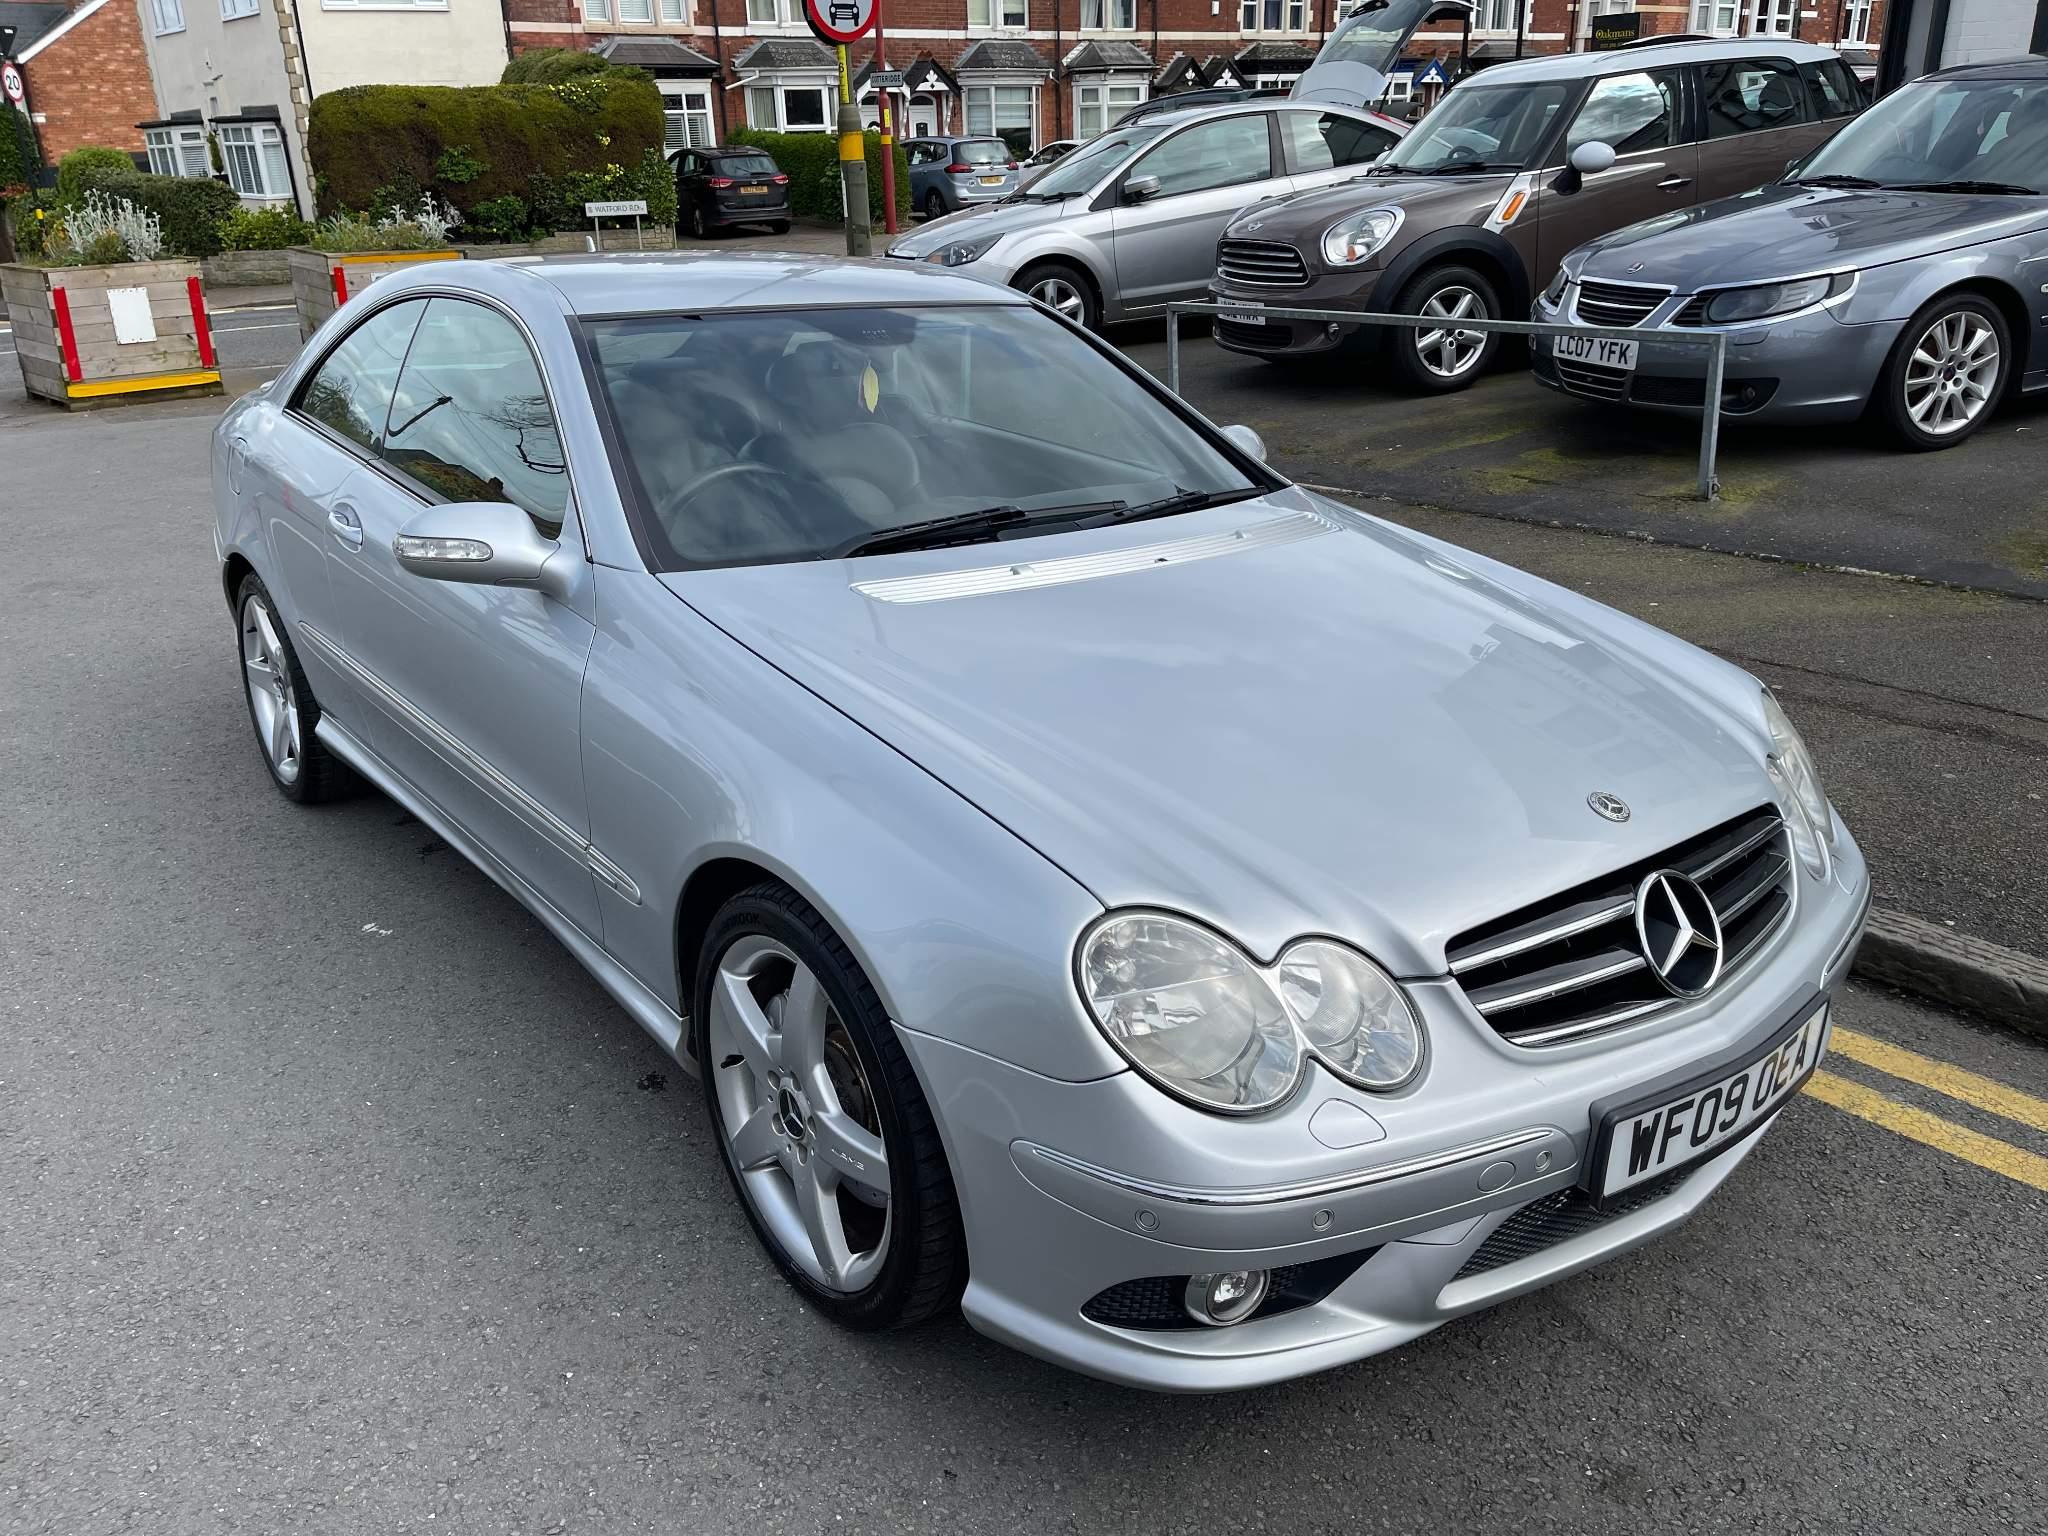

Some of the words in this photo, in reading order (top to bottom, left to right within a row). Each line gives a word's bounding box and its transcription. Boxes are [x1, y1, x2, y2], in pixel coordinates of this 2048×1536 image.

[1595, 28, 1635, 40] Oakmans
[6, 75, 20, 90] 20
[595, 205, 628, 213] WATFORD
[1558, 335, 1595, 359] LC07
[1599, 340, 1631, 365] YFK
[1627, 1072, 1750, 1178] WF09
[1752, 1019, 1812, 1112] OEA
